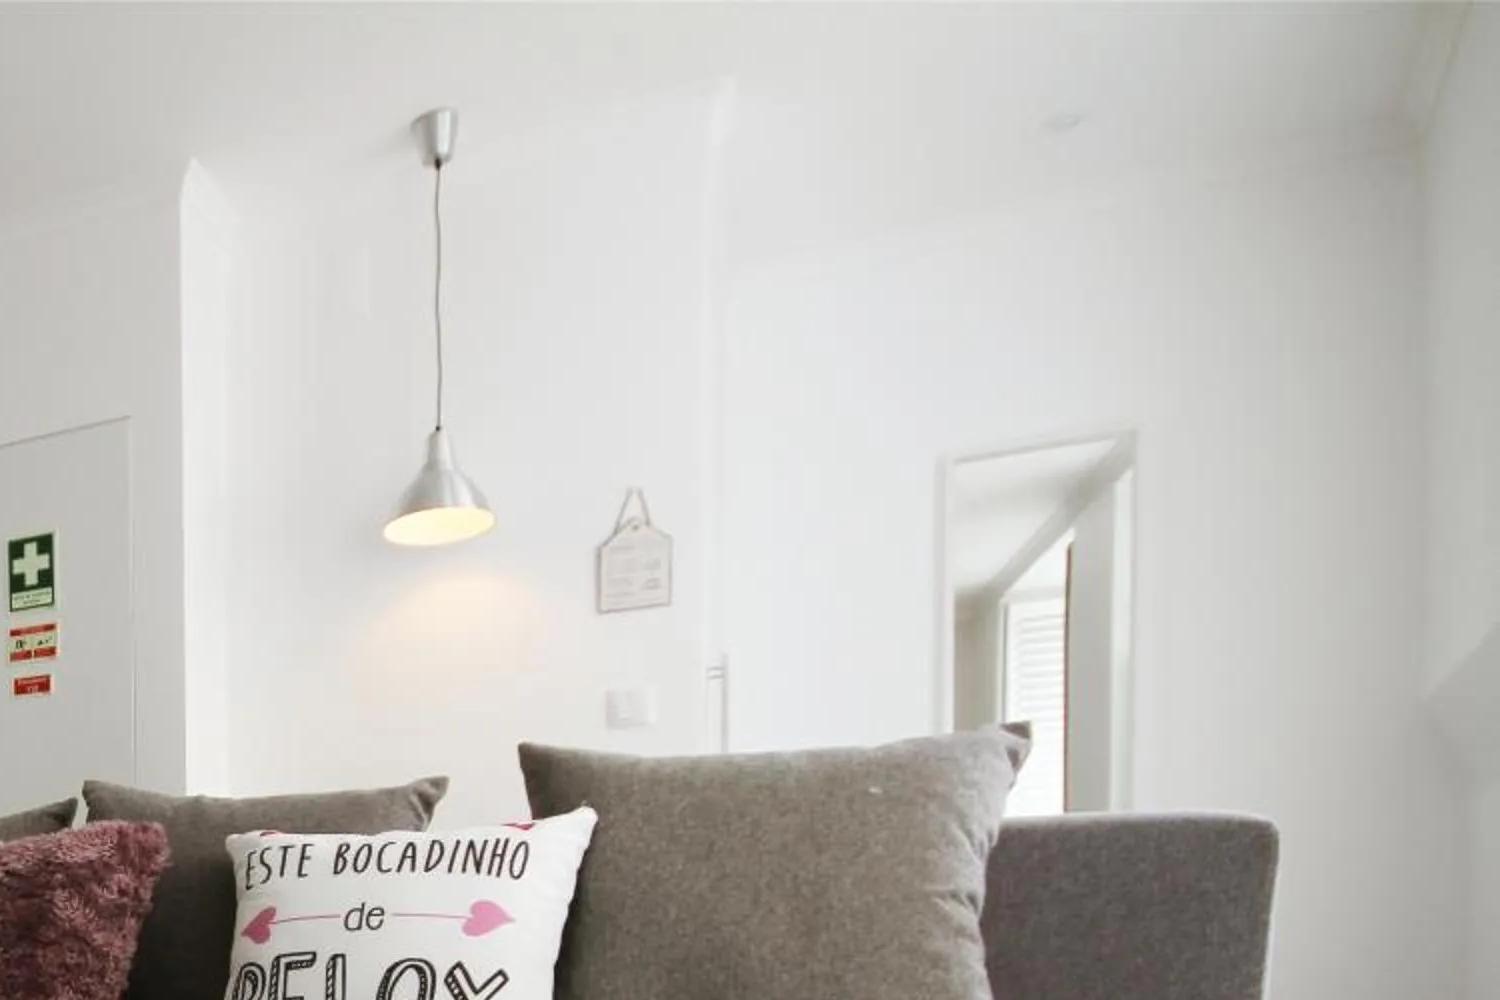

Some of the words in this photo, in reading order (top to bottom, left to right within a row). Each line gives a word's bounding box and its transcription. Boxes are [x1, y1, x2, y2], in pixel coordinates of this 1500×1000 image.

[245, 842, 314, 890] ESTE
[332, 837, 530, 880] BOCADINHO
[343, 902, 386, 931] de
